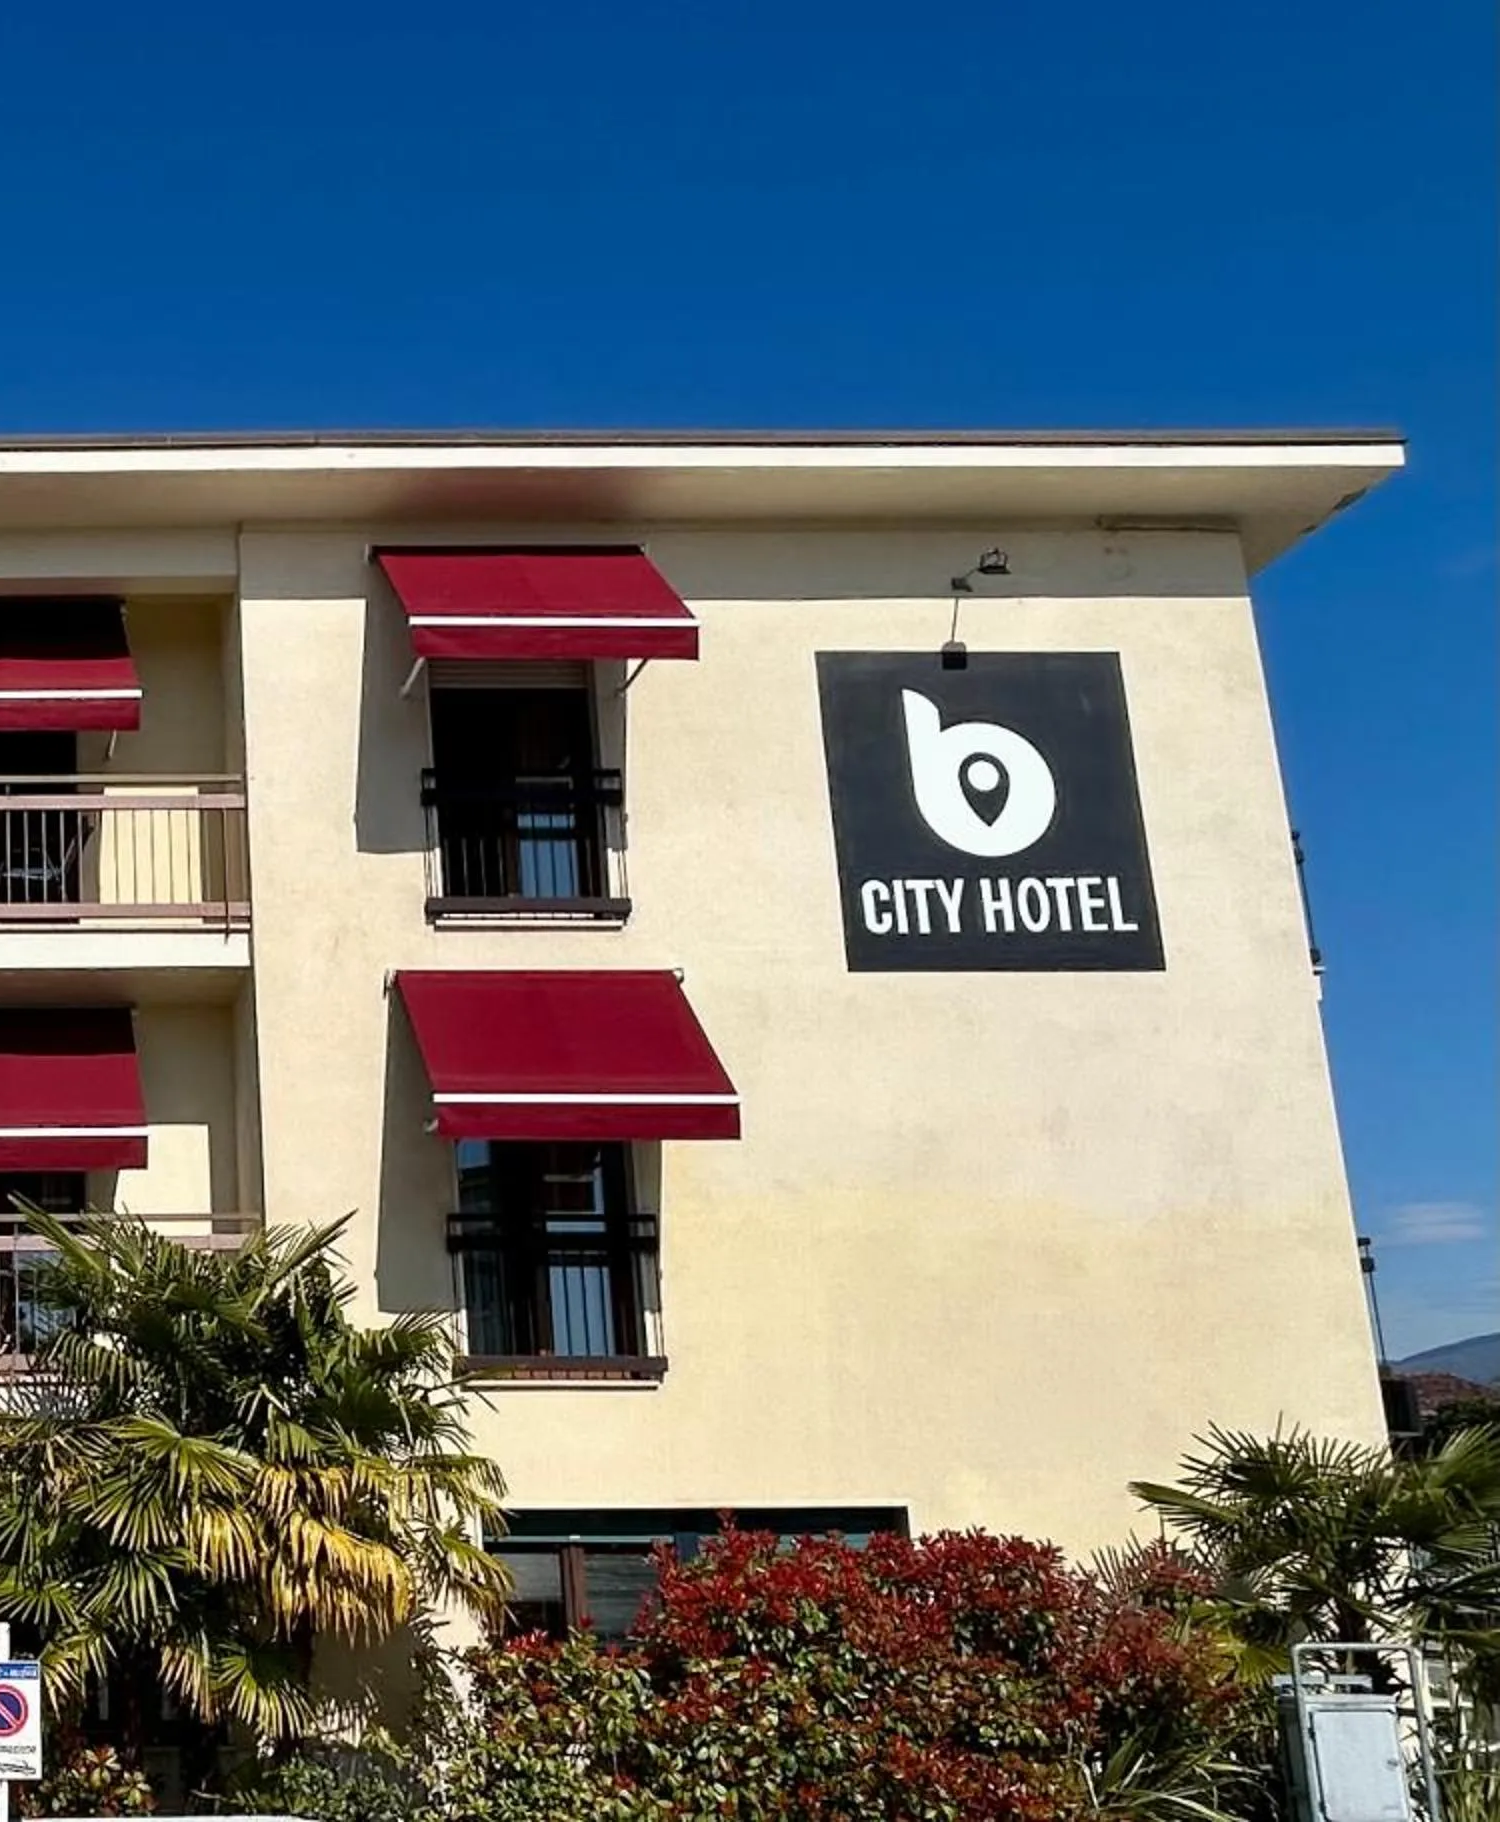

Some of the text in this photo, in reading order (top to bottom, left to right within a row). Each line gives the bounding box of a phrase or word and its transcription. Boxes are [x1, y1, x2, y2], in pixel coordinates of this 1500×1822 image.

[902, 688, 1056, 857] b
[861, 876, 1139, 935] CITY HOTEL
